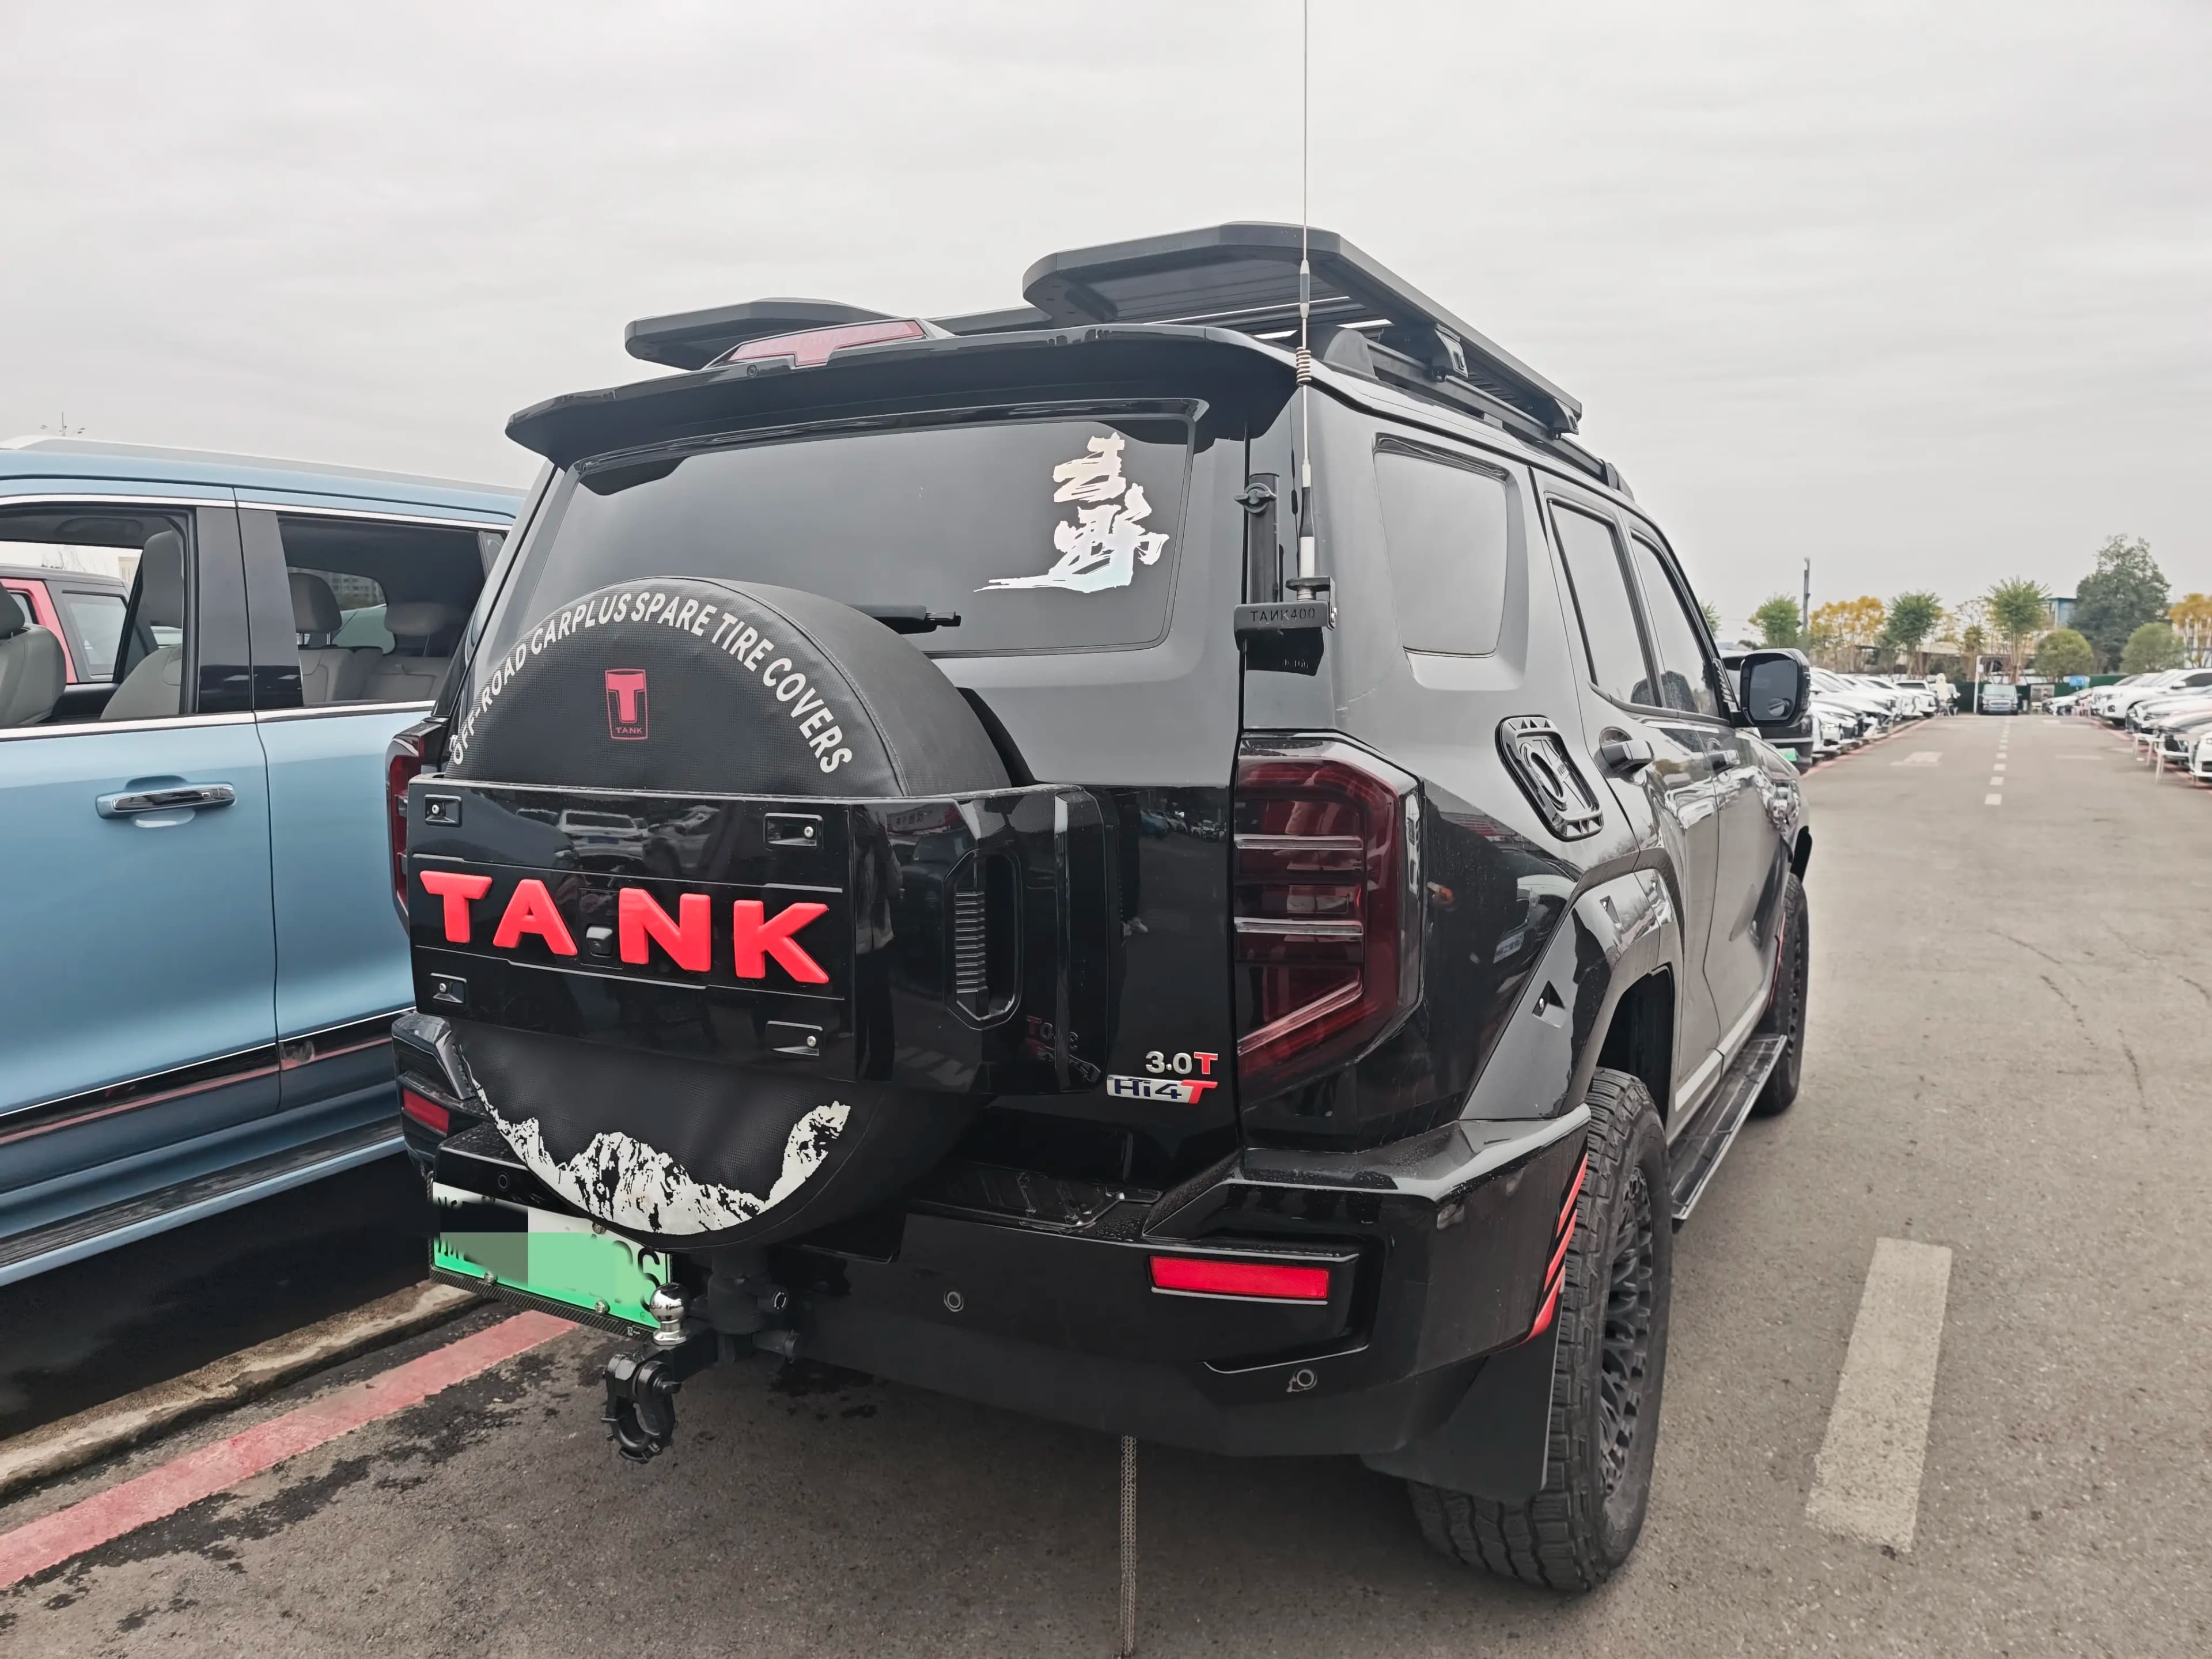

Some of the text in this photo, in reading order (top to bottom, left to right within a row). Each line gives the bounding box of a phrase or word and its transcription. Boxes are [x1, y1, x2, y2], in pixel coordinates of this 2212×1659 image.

[453, 592, 853, 773] OFF-ROAD CARPLUS SPARE TIRE COVERS
[616, 726, 643, 734] TANK
[419, 870, 830, 984] TANK
[1146, 1051, 1218, 1074] 3.0T
